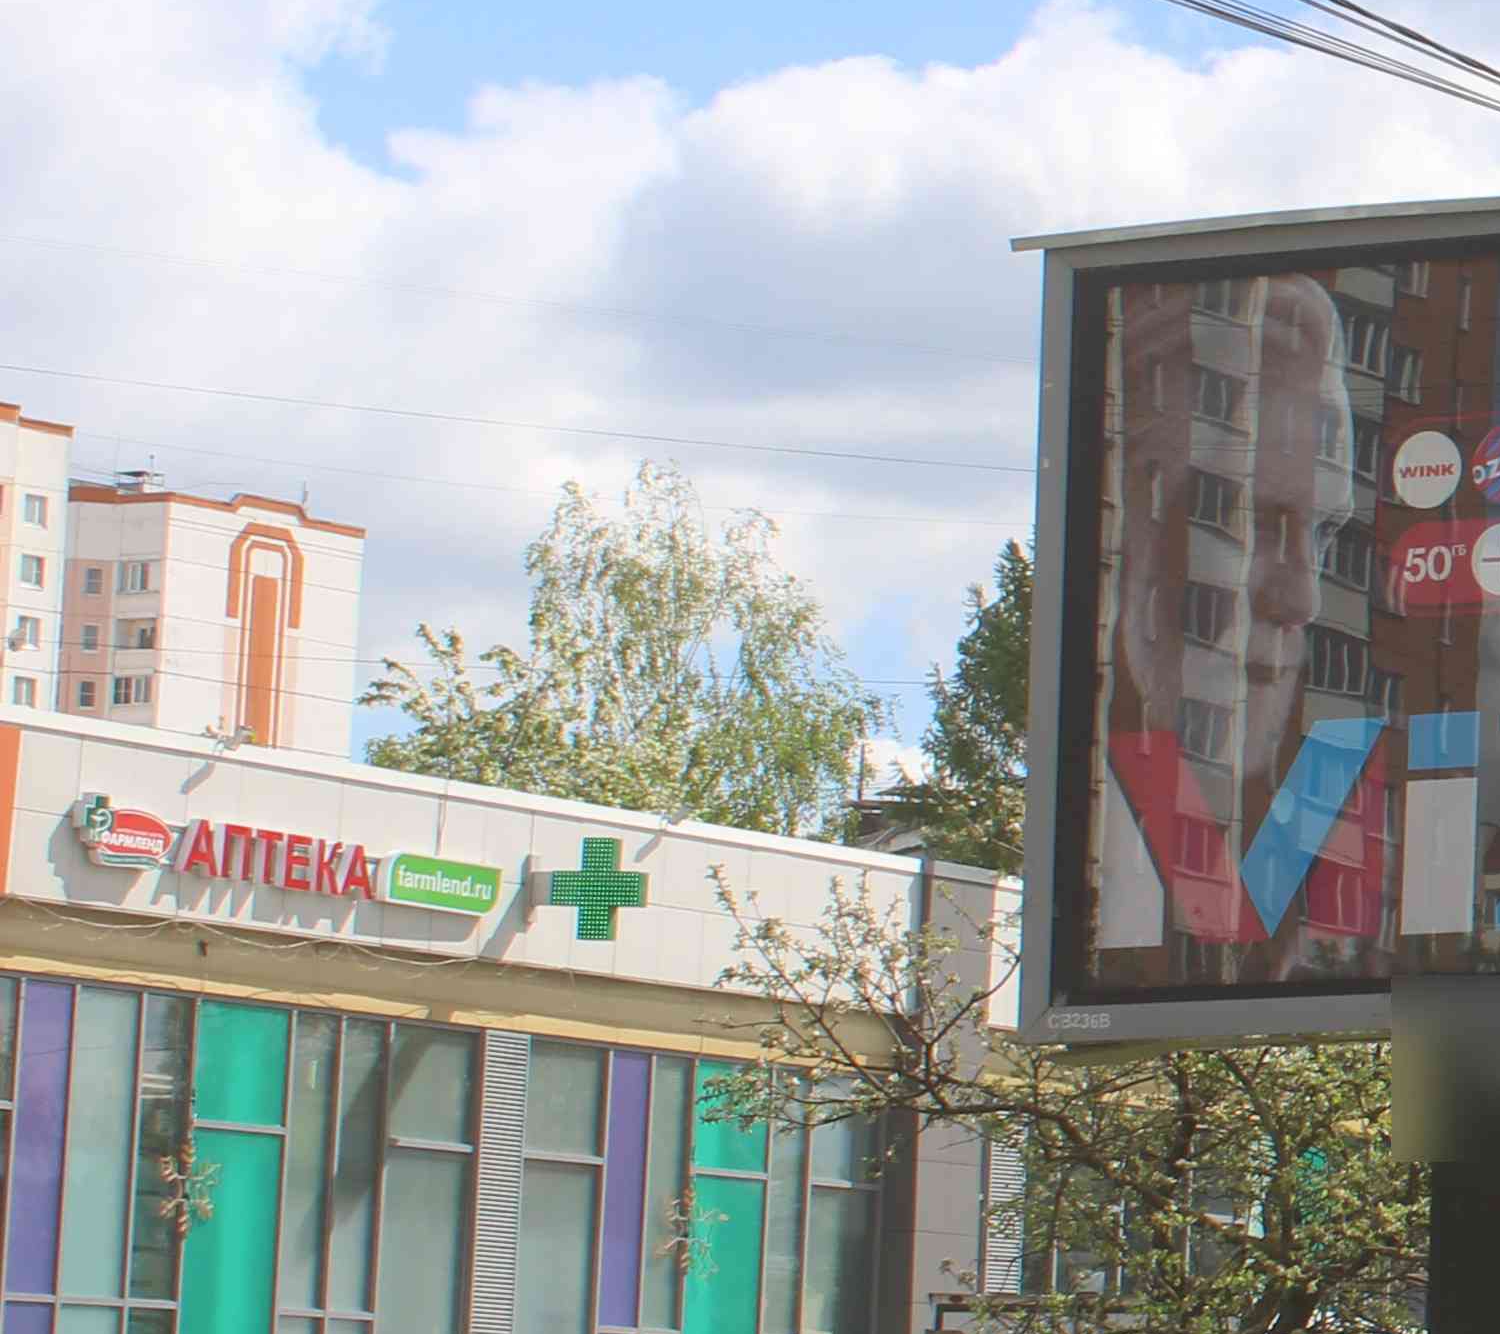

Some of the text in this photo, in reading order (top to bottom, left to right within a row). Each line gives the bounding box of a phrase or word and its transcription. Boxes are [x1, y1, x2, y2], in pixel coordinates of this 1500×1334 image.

[1400, 463, 1457, 479] WINK
[184, 818, 373, 901] АПТЕКА
[397, 864, 494, 901] farmlend.ru
